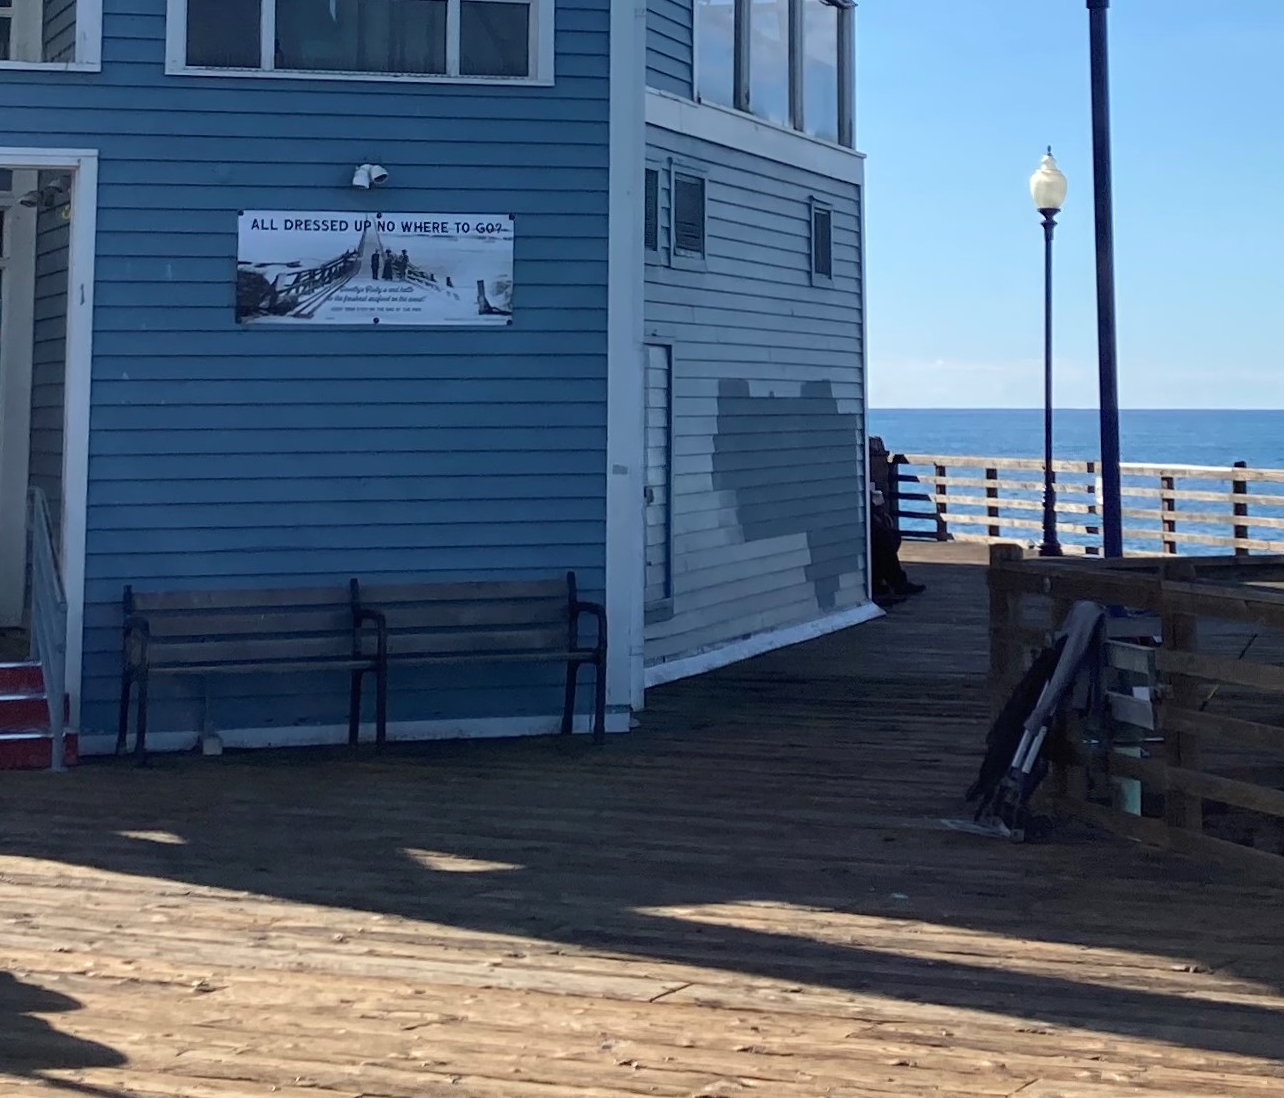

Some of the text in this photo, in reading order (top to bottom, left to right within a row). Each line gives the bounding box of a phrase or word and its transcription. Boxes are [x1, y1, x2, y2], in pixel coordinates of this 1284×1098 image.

[251, 218, 502, 234] ALL DRESSED UP NO WHERE TO GO?
